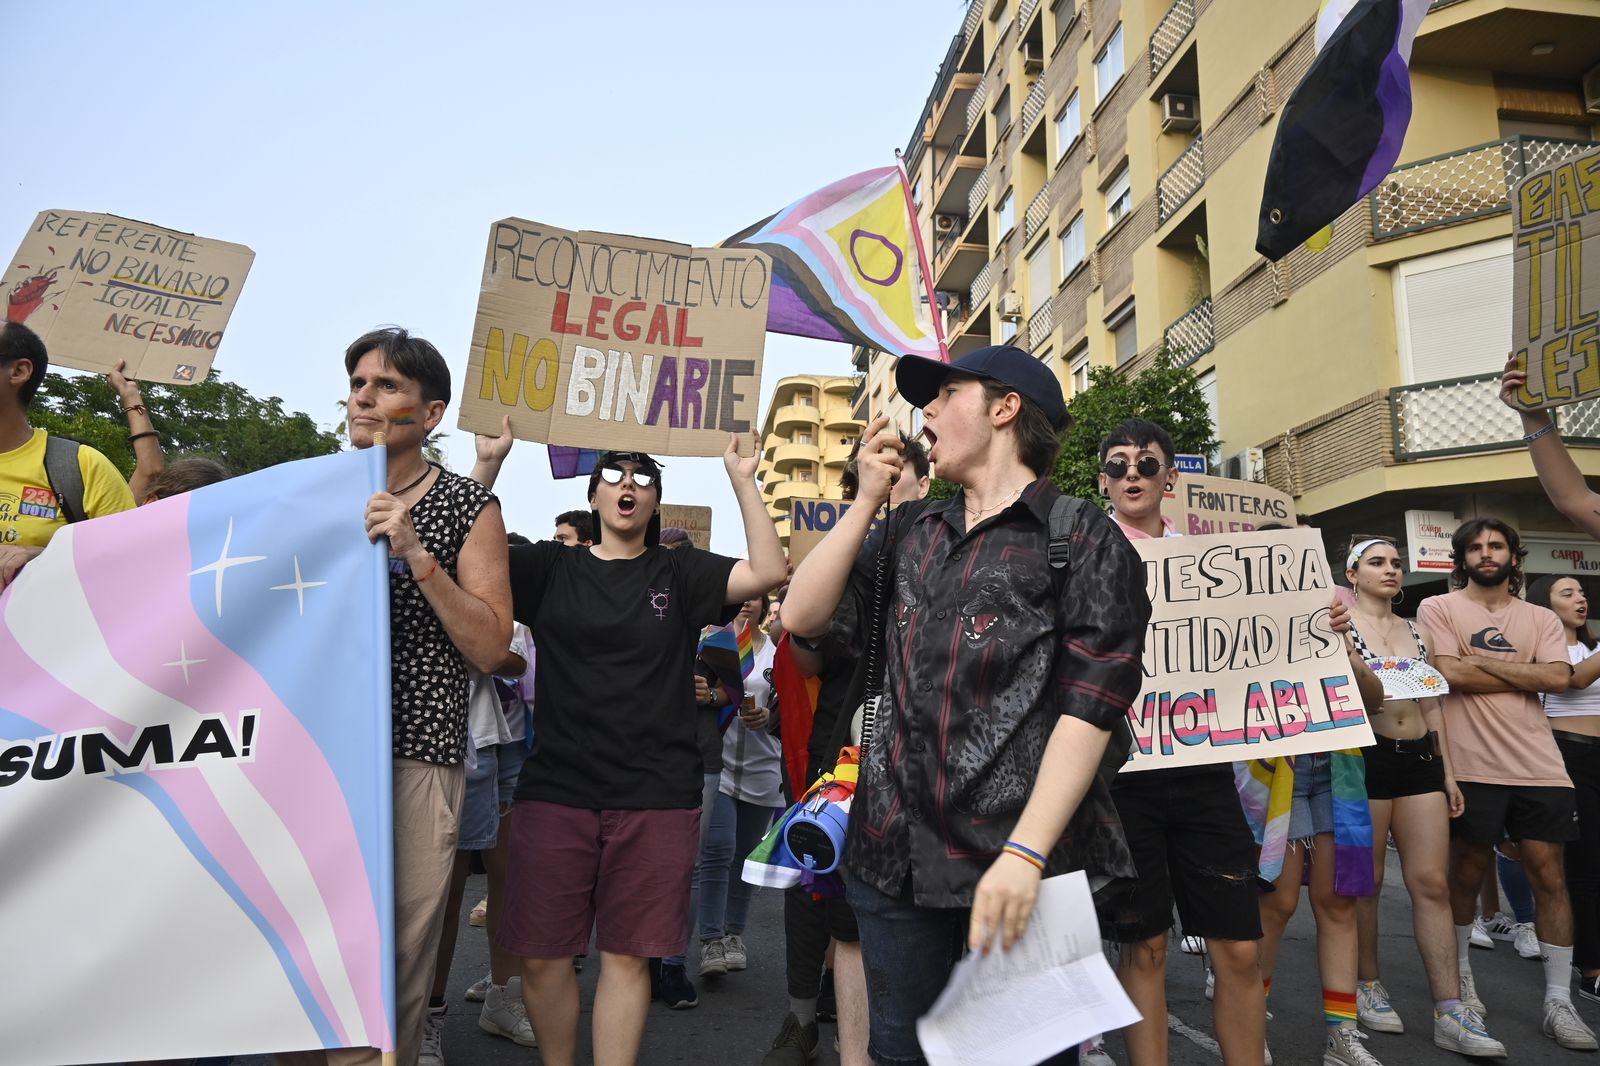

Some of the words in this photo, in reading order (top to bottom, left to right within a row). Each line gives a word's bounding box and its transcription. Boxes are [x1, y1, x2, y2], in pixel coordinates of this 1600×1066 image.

[37, 212, 203, 263] REFERENTE
[69, 247, 111, 275] NO
[114, 255, 230, 299] BINARIO
[492, 223, 767, 309] RECONOCIMIENTO
[1517, 221, 1599, 343] TIL
[550, 291, 704, 347] LEGAL
[479, 326, 561, 412] NO
[565, 344, 755, 433] BINARIE
[1174, 459, 1202, 470] VILLA
[21, 503, 55, 518] VOTA
[1187, 483, 1288, 519] FRONTERAS
[1288, 606, 1341, 664] ES
[1123, 675, 1366, 761] VIOLABLE
